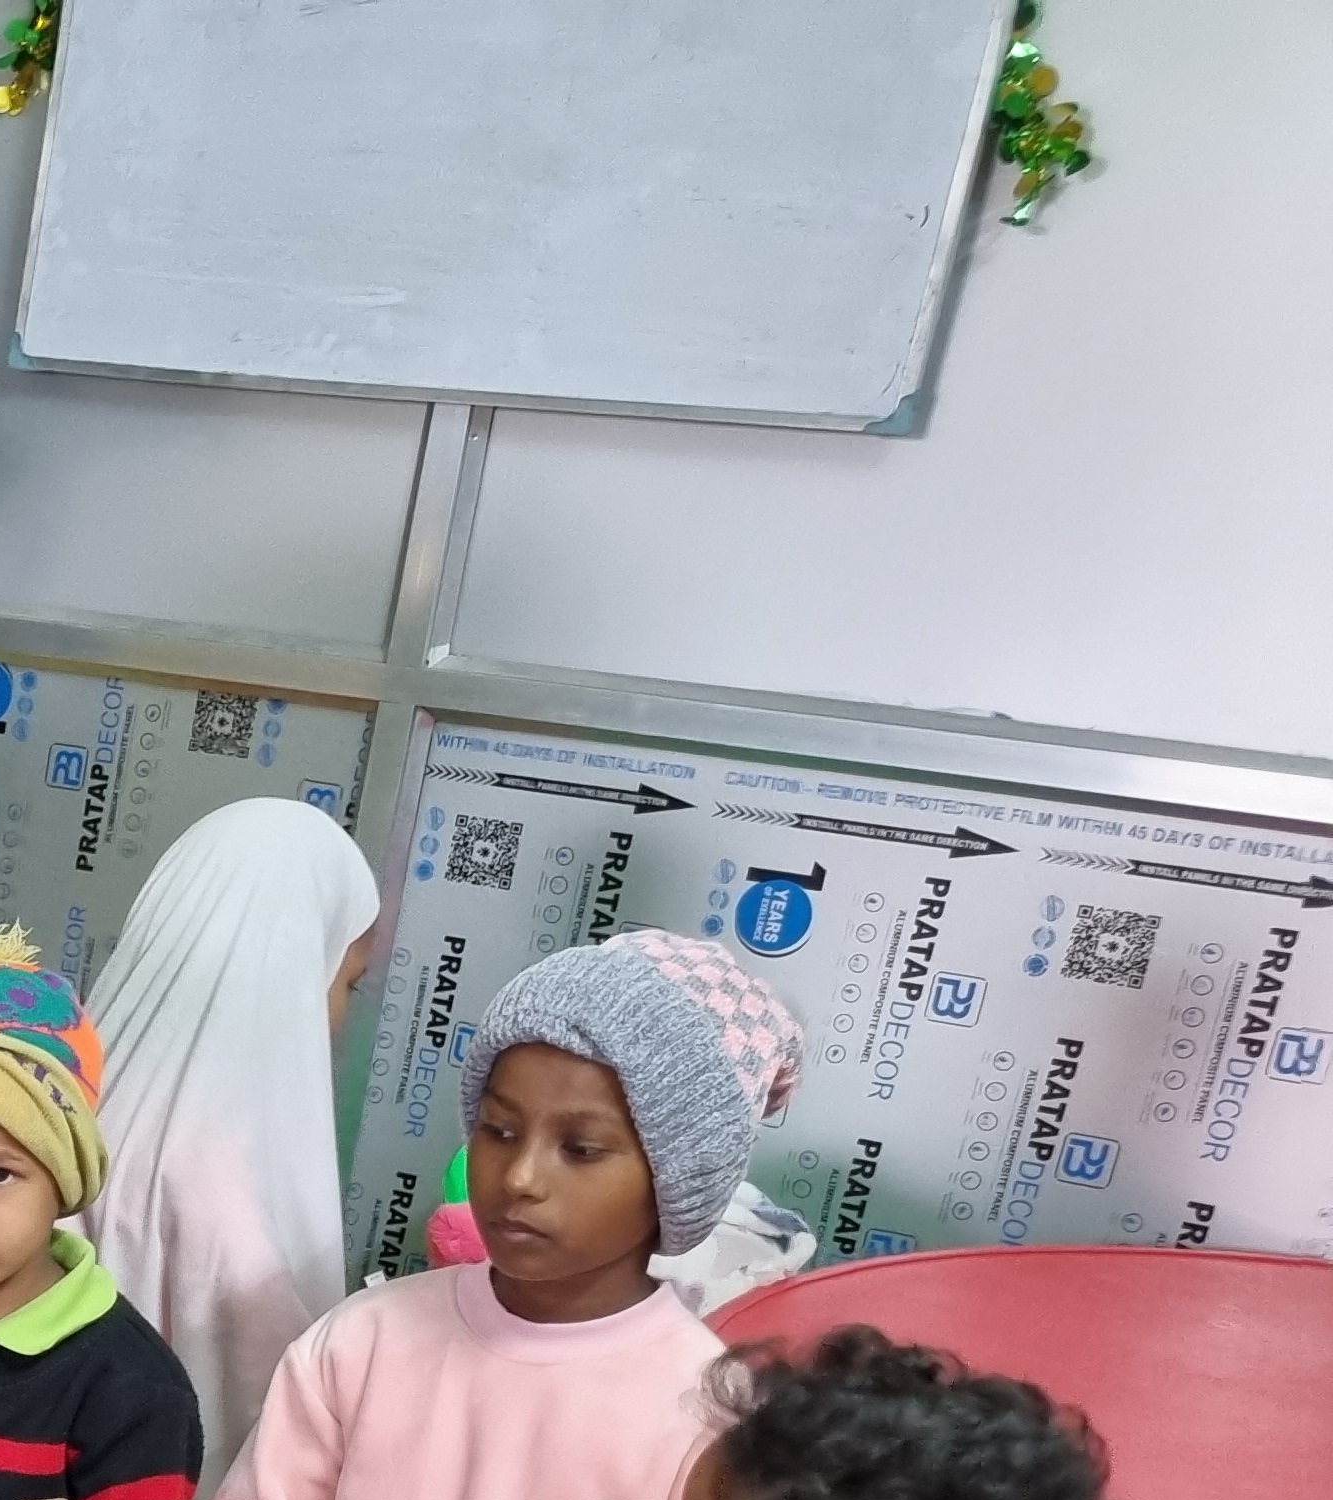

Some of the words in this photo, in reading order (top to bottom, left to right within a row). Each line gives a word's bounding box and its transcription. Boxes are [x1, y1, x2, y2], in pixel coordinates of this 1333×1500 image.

[1127, 824, 1148, 840] 45
[1151, 828, 1204, 848] DAYS
[1208, 835, 1235, 851] OF
[1238, 839, 1333, 865] INSTALLA
[763, 889, 790, 943] YEARS
[885, 909, 908, 969] ALUMINIUM
[868, 970, 891, 1030] COMPOSITE
[859, 1032, 876, 1065] PANEL
[1203, 1025, 1230, 1087] COMPOSITE
[1014, 1069, 1039, 1128] ALUMINIUM
[996, 1129, 1021, 1188] COMPOSITE
[833, 1138, 883, 1255] PRATAP
[986, 1191, 1004, 1223] PANEL
